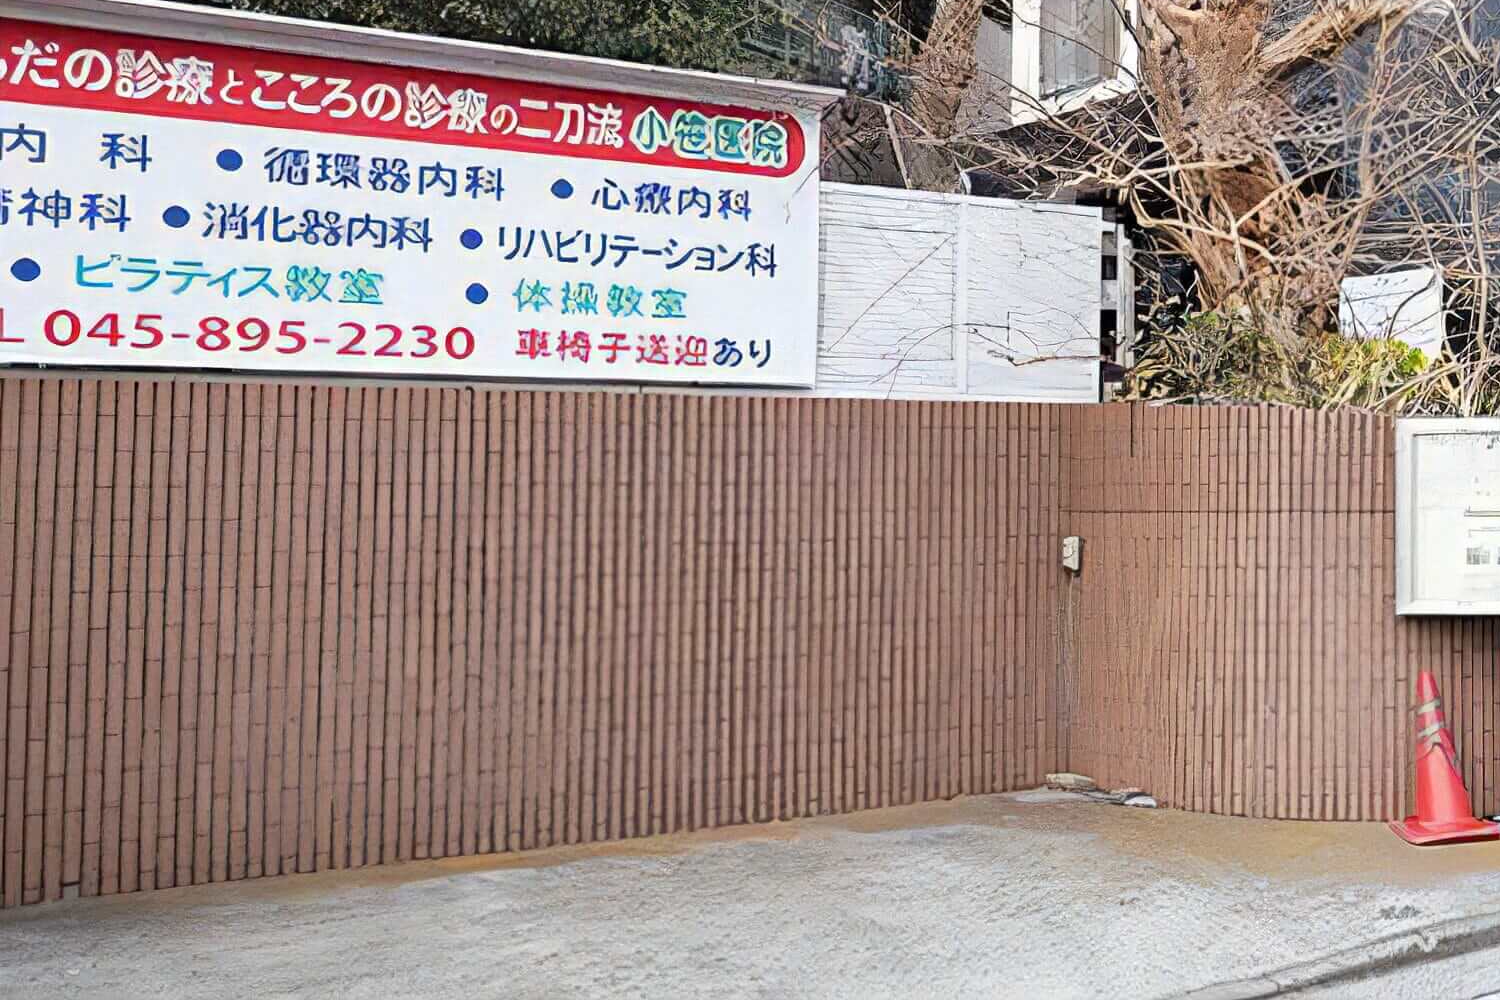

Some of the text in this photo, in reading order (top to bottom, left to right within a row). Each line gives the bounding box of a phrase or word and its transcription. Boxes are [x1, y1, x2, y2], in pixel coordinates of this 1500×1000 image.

[0, 39, 624, 148] だの診療とこころの診療の二刀流
[202, 202, 433, 253] 消化器内科
[498, 226, 777, 278] リハビリテーション科
[44, 309, 475, 359] 045-895-2230
